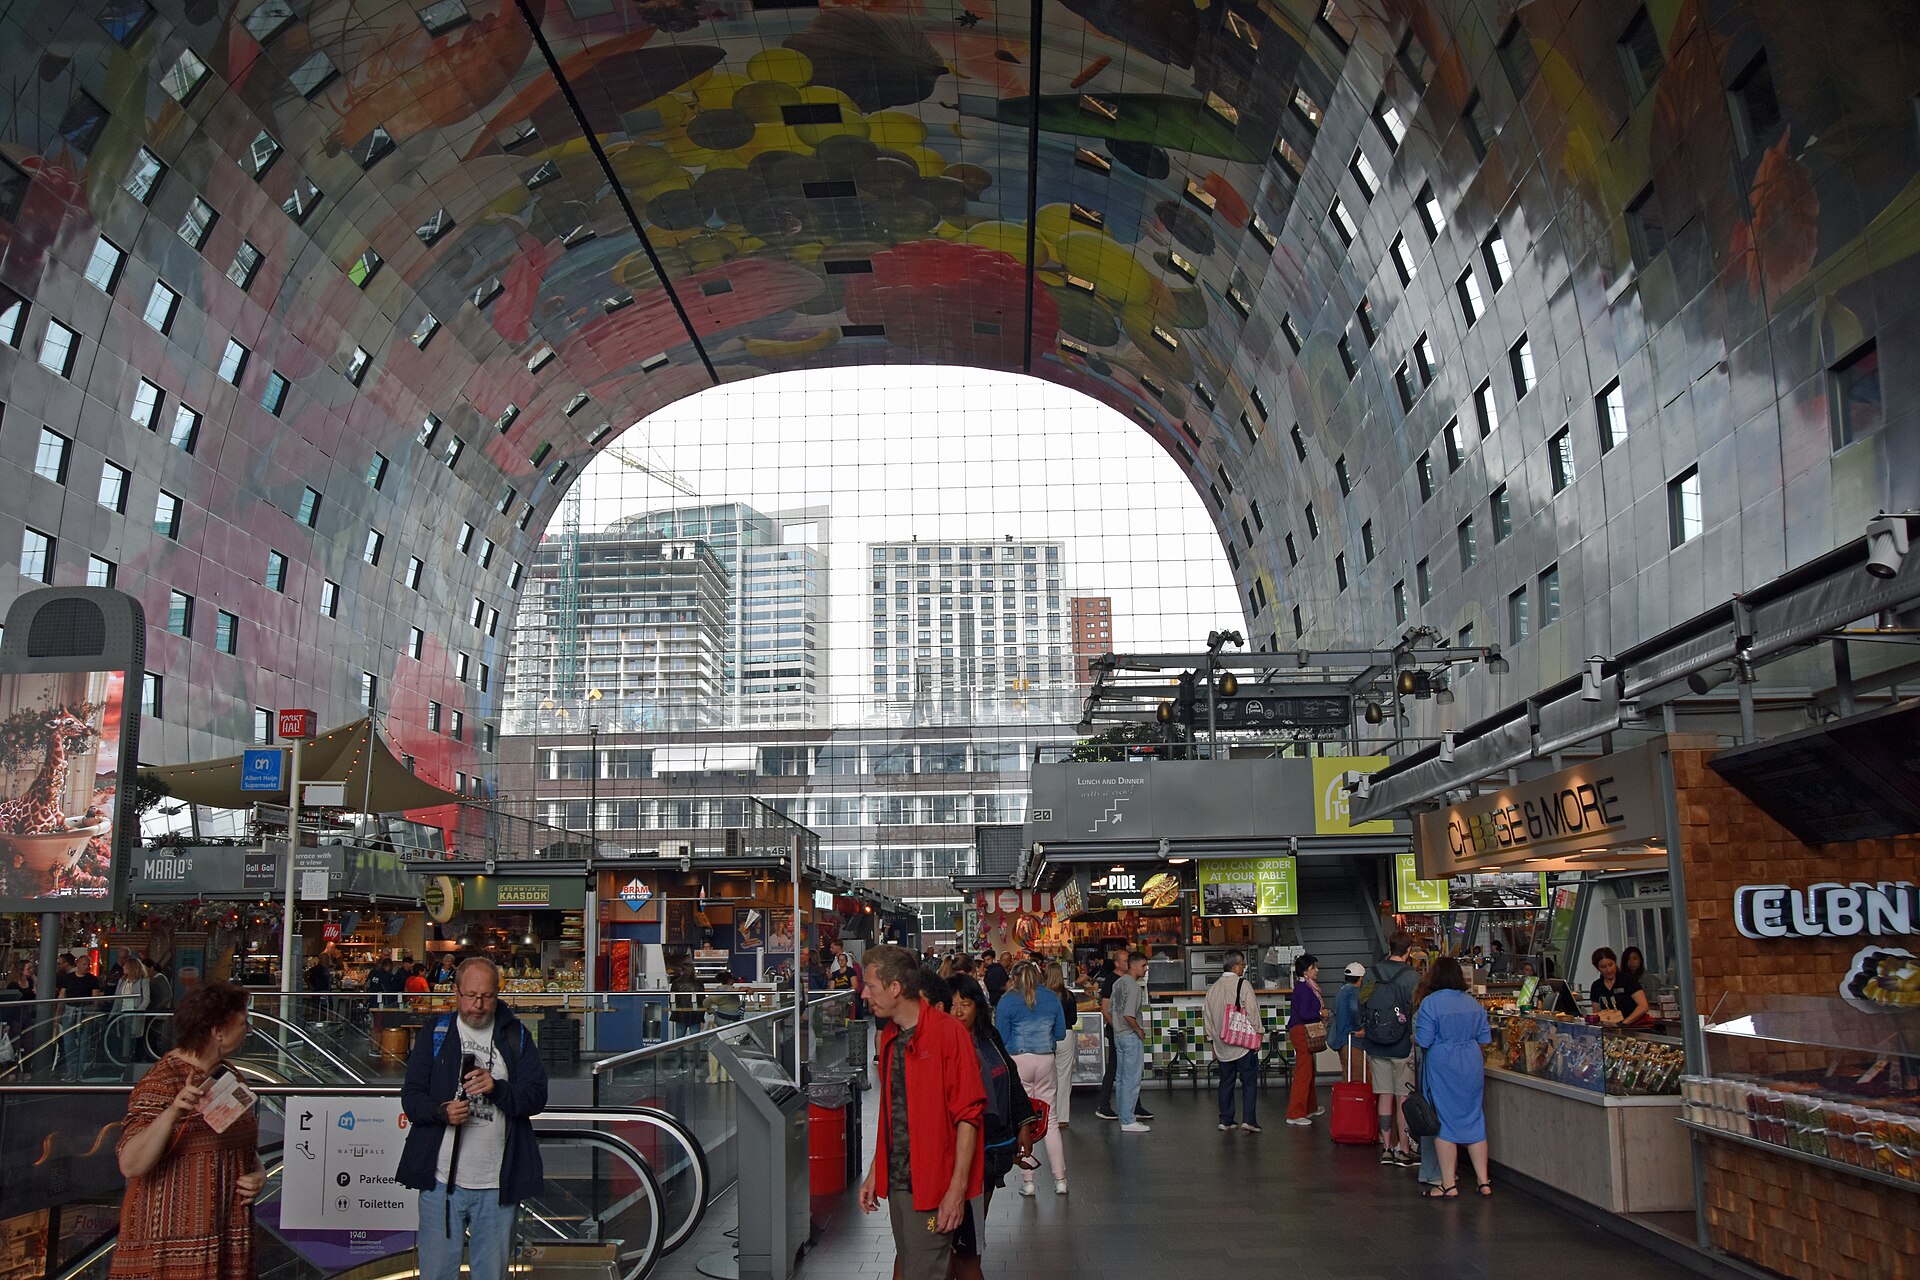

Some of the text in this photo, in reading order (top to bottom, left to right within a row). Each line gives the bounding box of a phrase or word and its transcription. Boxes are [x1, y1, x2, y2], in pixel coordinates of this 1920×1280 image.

[283, 722, 299, 732] HAL
[1332, 801, 1350, 820] Tu
[1524, 801, 1543, 839] &
[1540, 777, 1625, 836] MORE
[1034, 811, 1050, 820] 20
[1204, 862, 1227, 870] YOU
[1257, 861, 1291, 869] ORDER
[1401, 857, 1415, 866] YO
[144, 859, 192, 880] MARIO'S
[1210, 871, 1286, 881] AT YOUR TABLE
[1109, 875, 1136, 889] PIDE
[500, 892, 547, 900] KAASDOK
[1750, 884, 1920, 938] ELBN
[324, 926, 339, 939] illy
[358, 1199, 404, 1209] Toiletten
